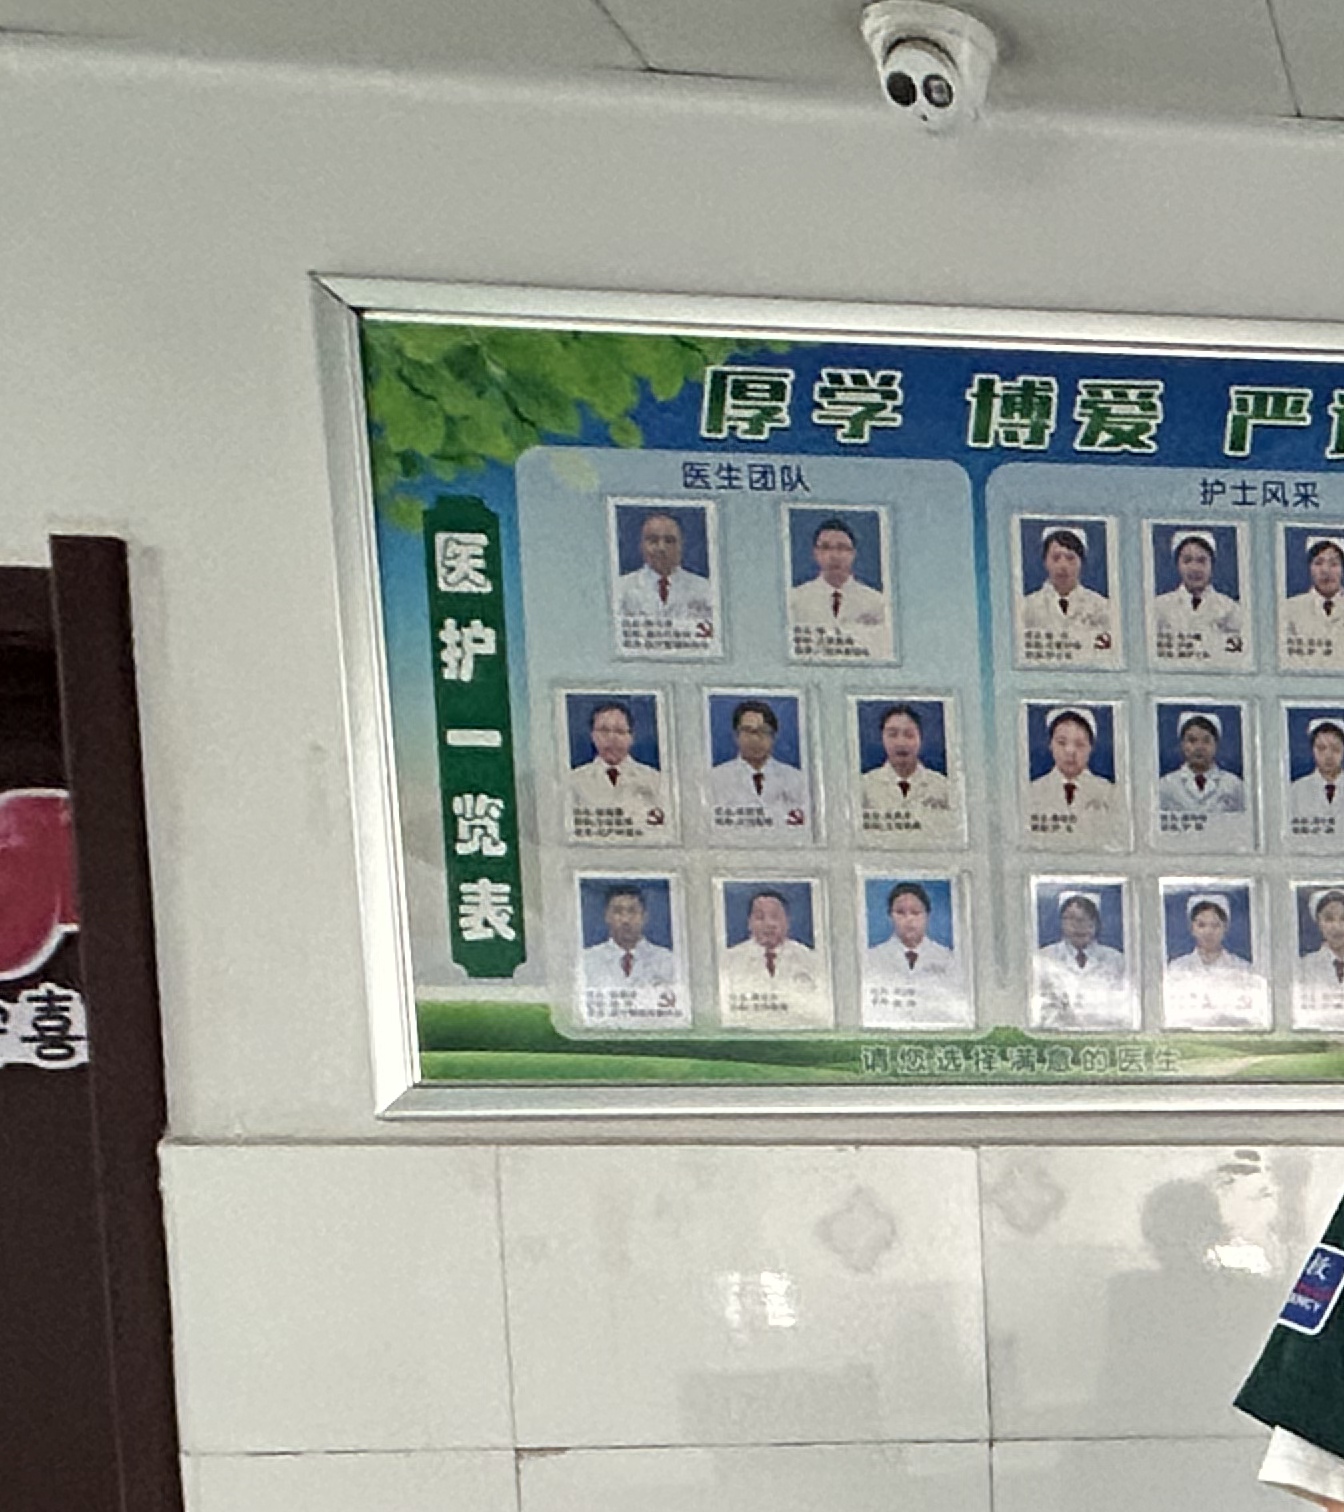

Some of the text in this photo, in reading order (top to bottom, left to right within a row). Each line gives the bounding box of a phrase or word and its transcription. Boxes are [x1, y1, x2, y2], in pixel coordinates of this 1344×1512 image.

[700, 366, 903, 444] 厚学
[966, 374, 1164, 452] 博爱
[682, 461, 811, 491] 医生团队
[1198, 477, 1319, 508] 护士风采
[434, 532, 516, 941] 医护一览表
[0, 989, 86, 1061] 喜
[861, 1045, 1181, 1074] 请您选择满意的医生
